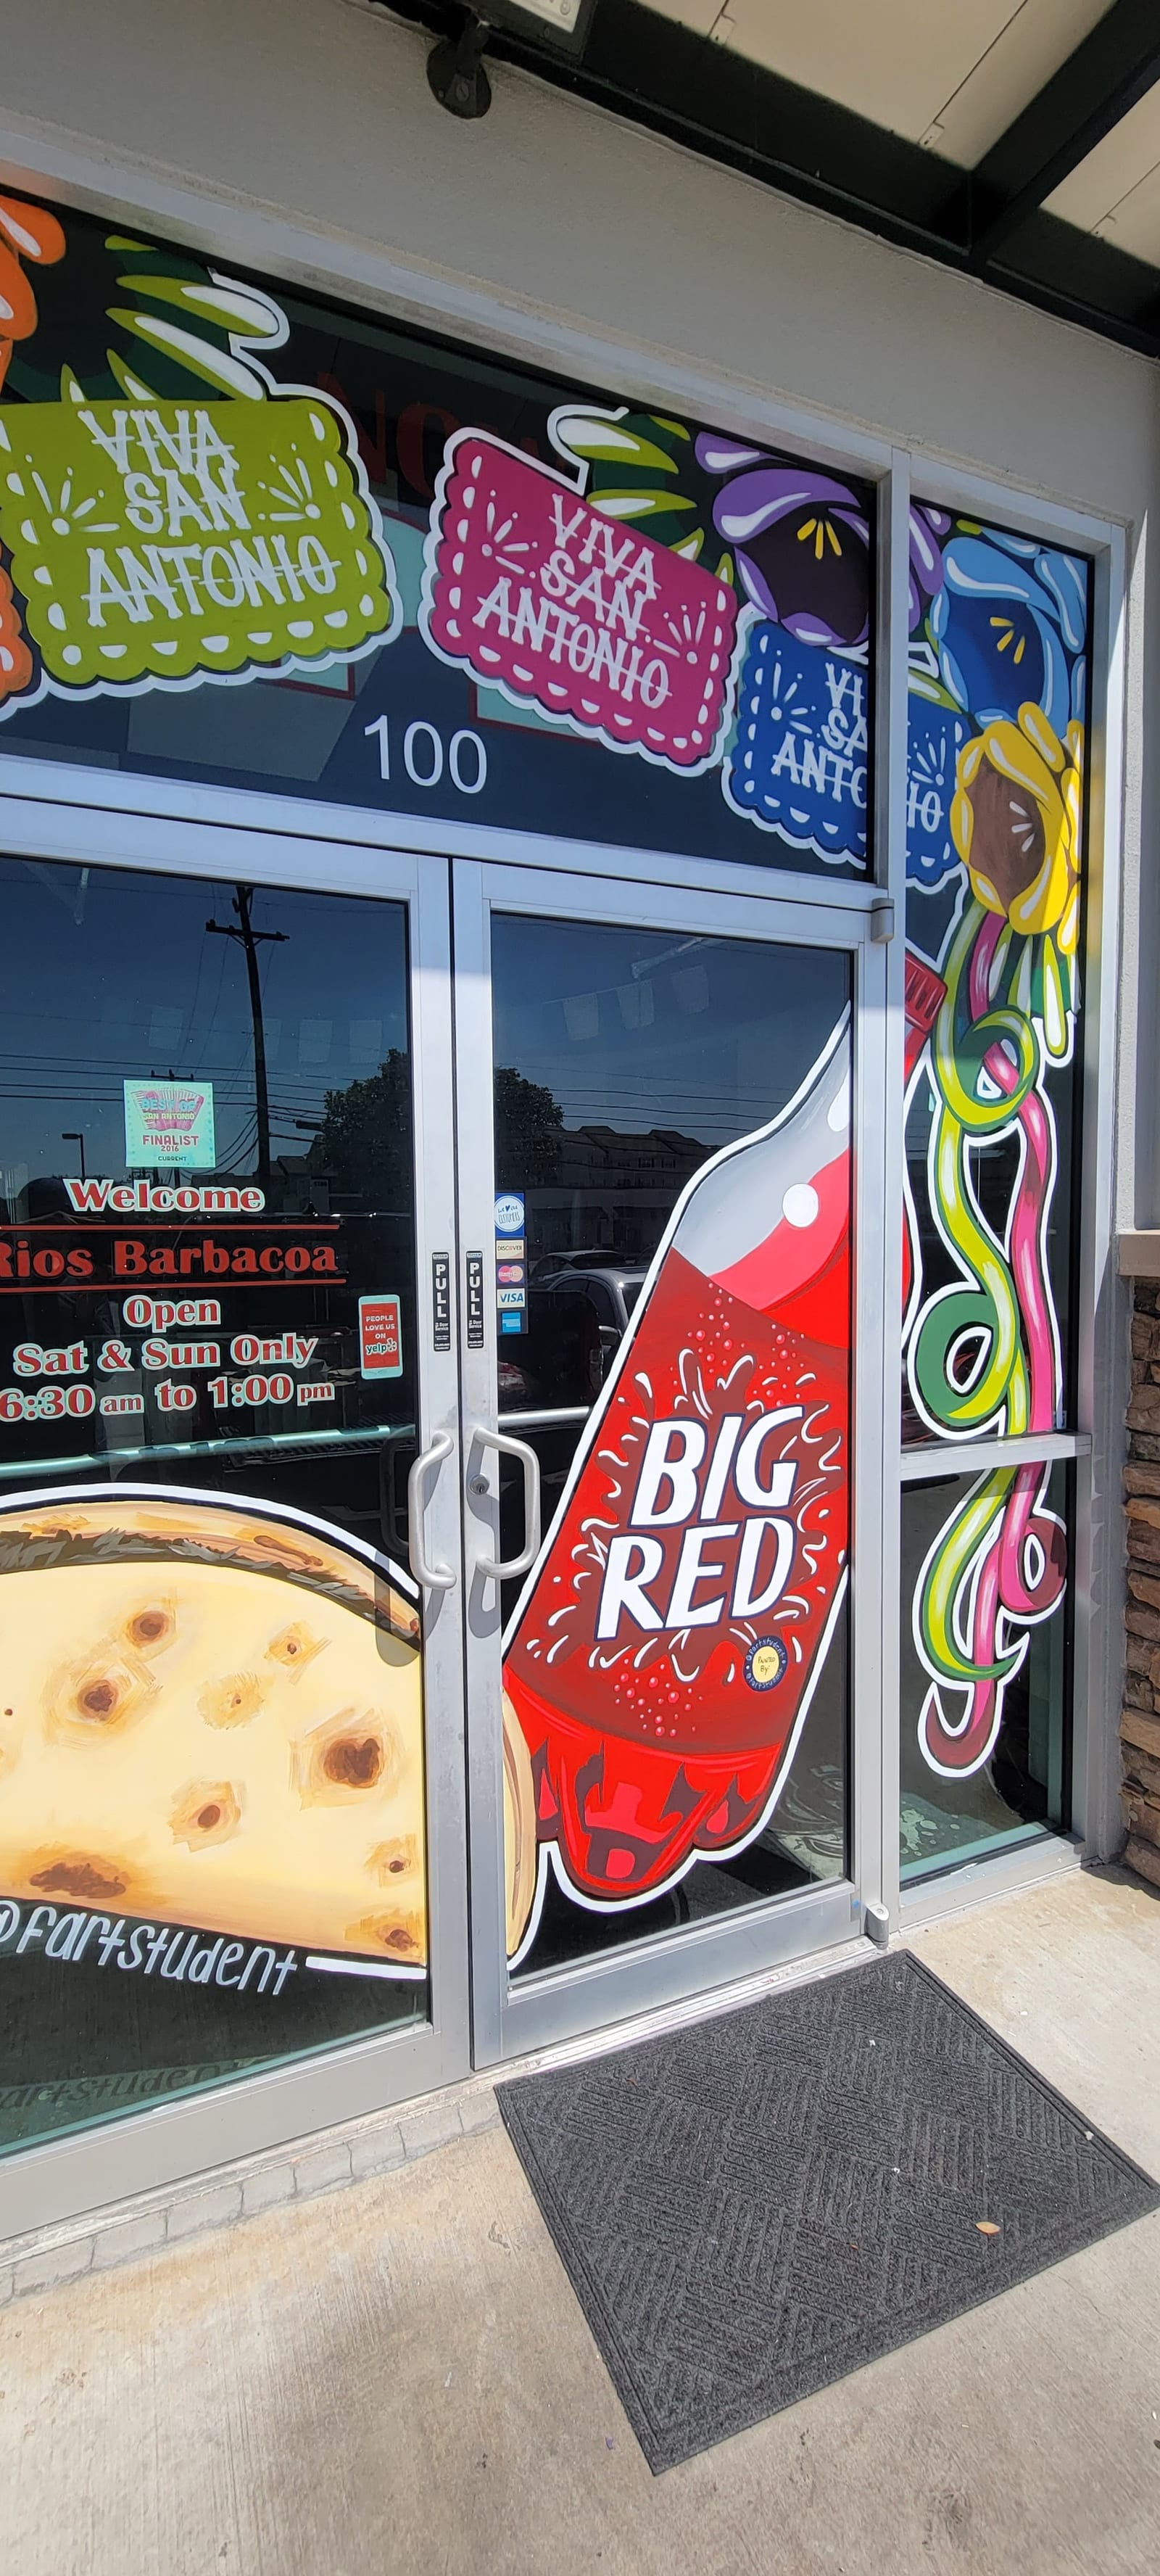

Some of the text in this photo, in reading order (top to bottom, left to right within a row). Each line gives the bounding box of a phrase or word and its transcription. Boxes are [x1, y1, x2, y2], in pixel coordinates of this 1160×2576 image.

[78, 409, 240, 475] VIVA
[124, 468, 252, 537] SAN
[549, 493, 661, 600] VIVA
[81, 534, 341, 628] ANTONIO
[540, 550, 650, 640] SAN
[472, 577, 673, 709] ANTONIO
[364, 714, 488, 793] 100
[821, 707, 868, 757] SA
[142, 1134, 199, 1146] FINALIST
[63, 1178, 265, 1212] Welcome
[114, 1239, 339, 1276] Barbacoa
[123, 1294, 221, 1333] Open
[435, 1263, 447, 1318] PULL
[469, 1262, 481, 1316] PULL
[500, 1292, 524, 1303] VISA
[13, 1333, 319, 1376] Sat & Sun Only
[365, 1343, 387, 1355] yelp
[0, 1374, 335, 1421] 6:30 am to 1:00 pm
[628, 1405, 805, 1529] BIG
[594, 1515, 798, 1641] RED
